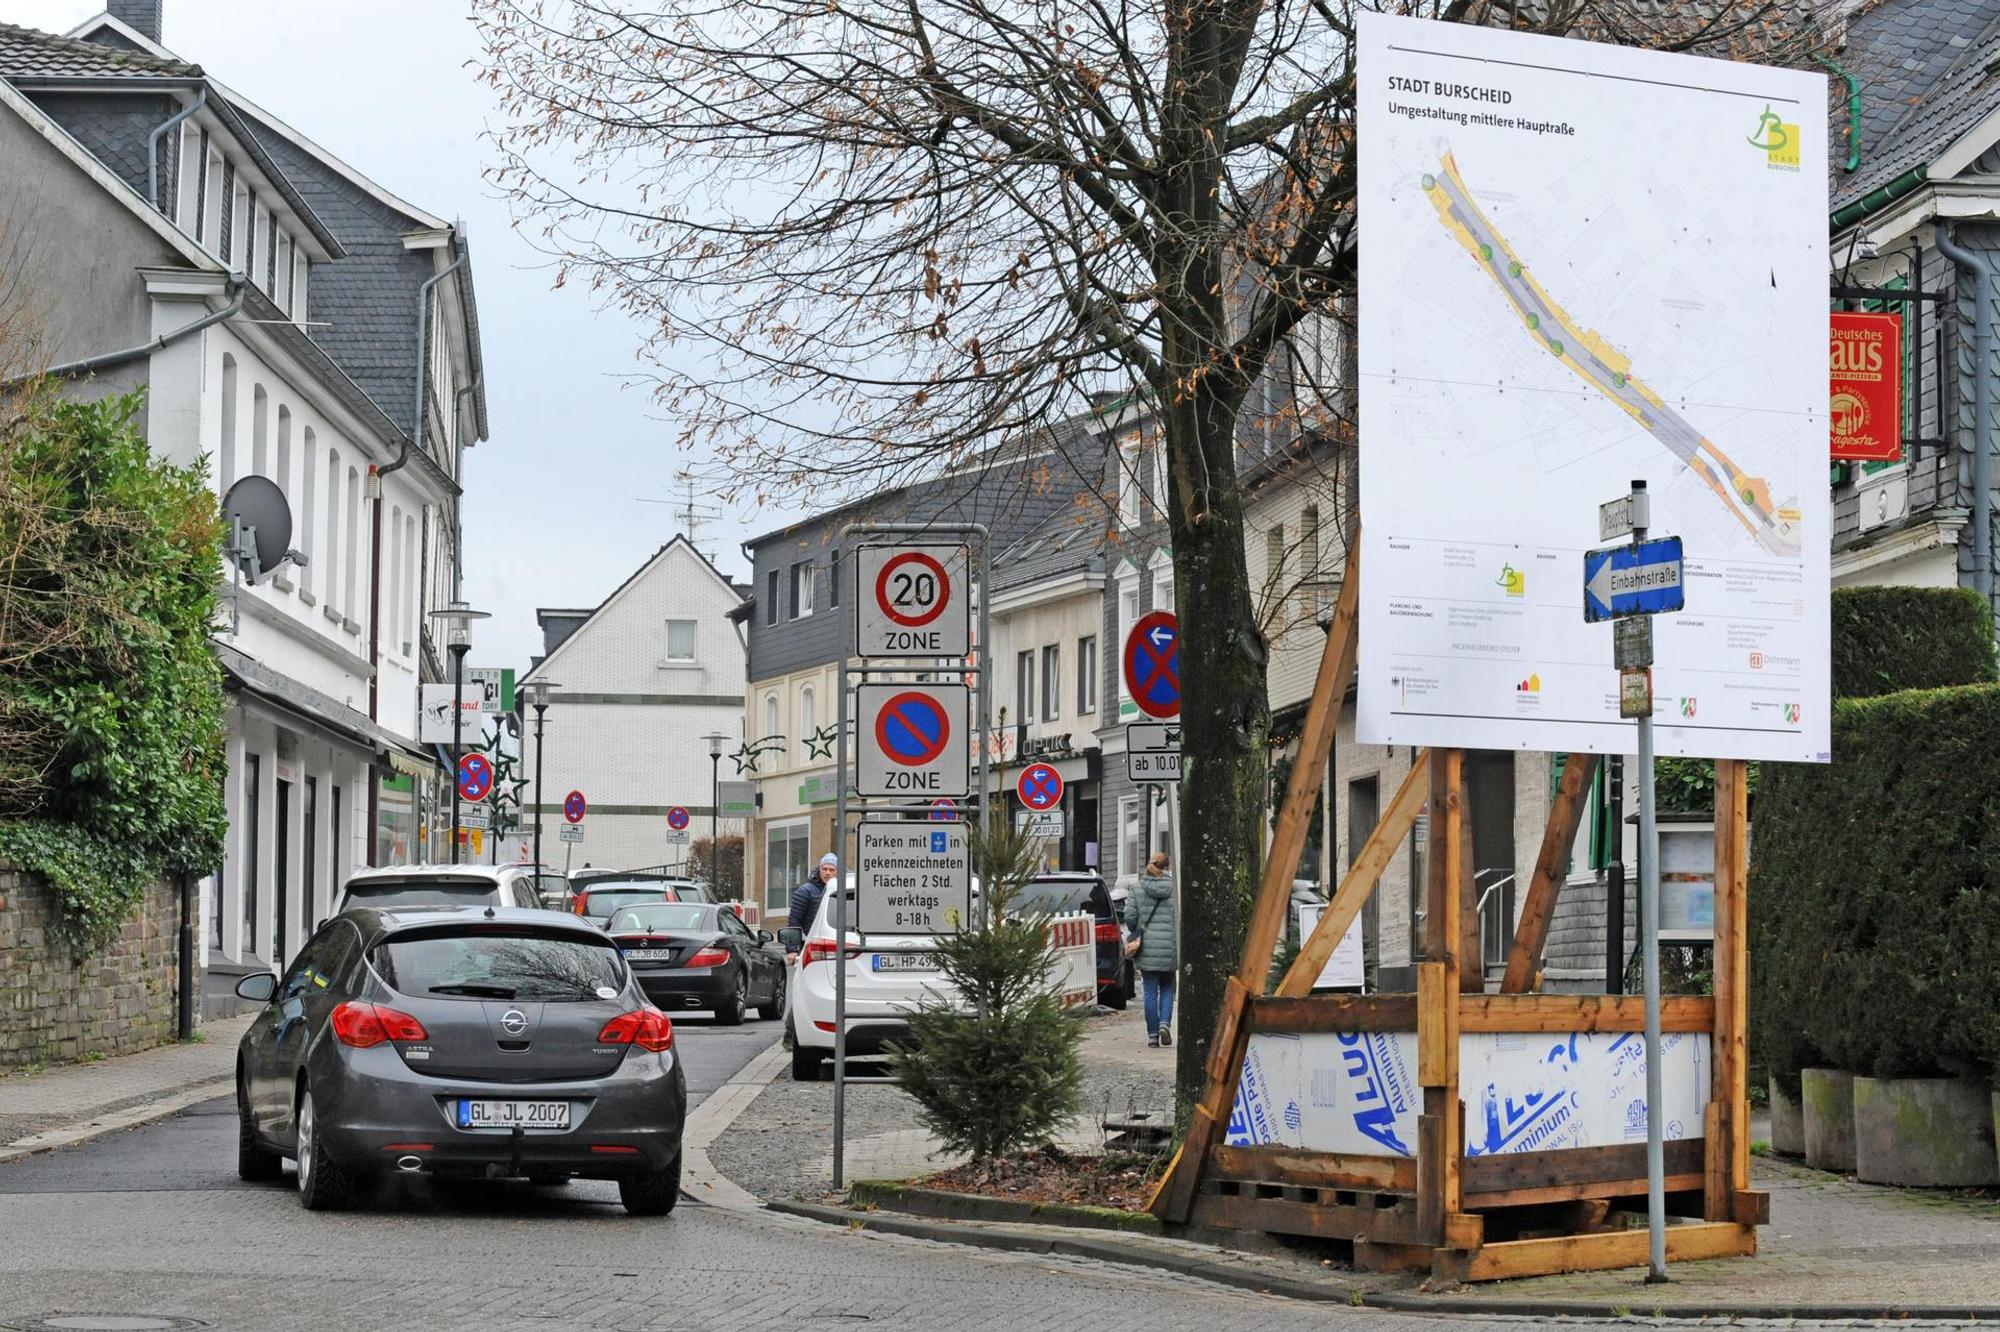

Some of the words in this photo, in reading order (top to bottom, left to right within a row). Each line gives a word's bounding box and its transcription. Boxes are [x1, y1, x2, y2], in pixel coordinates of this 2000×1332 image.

[1388, 76, 1430, 94] STADT
[1434, 82, 1512, 104] BURSCHEID
[1388, 102, 1467, 126] Umgestaltung
[1470, 112, 1515, 129] mittlere
[1517, 118, 1575, 136] Hauptraße
[1831, 328, 1882, 340] Deutsches
[1831, 341, 1882, 371] aus
[1831, 434, 1880, 449] agosta
[1611, 567, 1676, 590] Einbahnstraße
[893, 573, 934, 606] 20
[886, 632, 941, 650] ZONE
[482, 702, 498, 710] TORY
[1135, 756, 1149, 771] ab
[1155, 756, 1181, 771] 10.01
[885, 772, 941, 789] ZONE
[865, 834, 903, 848] Parken
[909, 834, 927, 848] mit
[950, 835, 960, 848] in
[864, 855, 963, 872] gekennzeichneten
[873, 874, 916, 888] Flächen
[921, 875, 928, 888] 2
[932, 875, 952, 888] Std.
[887, 894, 939, 910] werktags
[879, 954, 894, 967] GL
[901, 954, 916, 967] HP
[1243, 1055, 1259, 1102] Pane
[471, 1103, 491, 1120] GL
[503, 1103, 523, 1120] JL
[528, 1104, 567, 1121] 2007
[1254, 1103, 1271, 1146] osite
